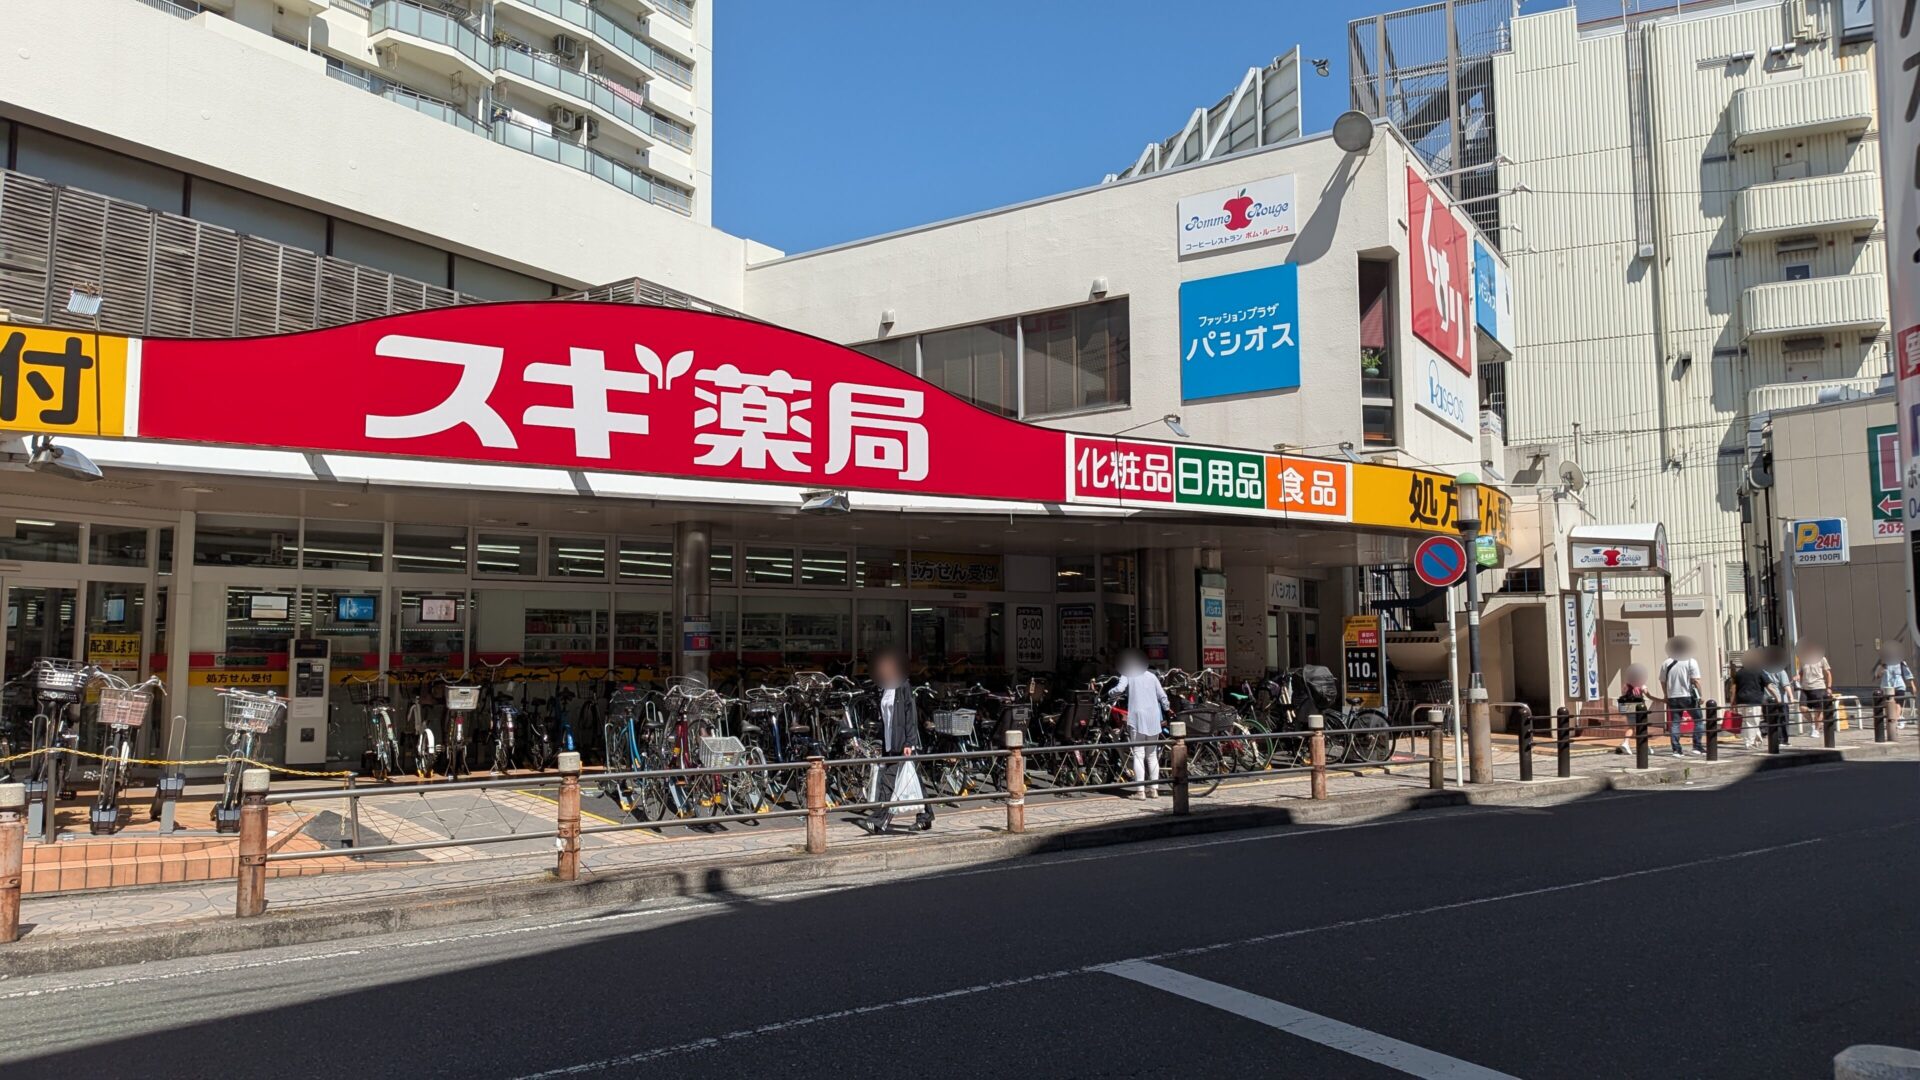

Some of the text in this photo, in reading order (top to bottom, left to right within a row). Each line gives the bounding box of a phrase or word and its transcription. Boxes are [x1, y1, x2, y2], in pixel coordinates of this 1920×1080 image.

[1185, 202, 1289, 231] Pomme Rouge
[1185, 234, 1243, 251] コーヒーレストラン
[1199, 302, 1280, 328] ファッションプラザ
[1186, 323, 1296, 361] パシオス
[1428, 359, 1464, 424] Paseos
[365, 334, 929, 482] スギ薬局
[1077, 447, 1172, 494] 化粧品
[1178, 457, 1262, 500] 日用品
[1277, 466, 1337, 507] 食品
[1815, 534, 1841, 549] 24H
[1799, 553, 1840, 562] 20分 100円
[1271, 581, 1298, 600] パシオス
[1022, 617, 1042, 630] 9:00
[1018, 637, 1042, 650] 23:00
[206, 673, 272, 684] 処方せん受付
